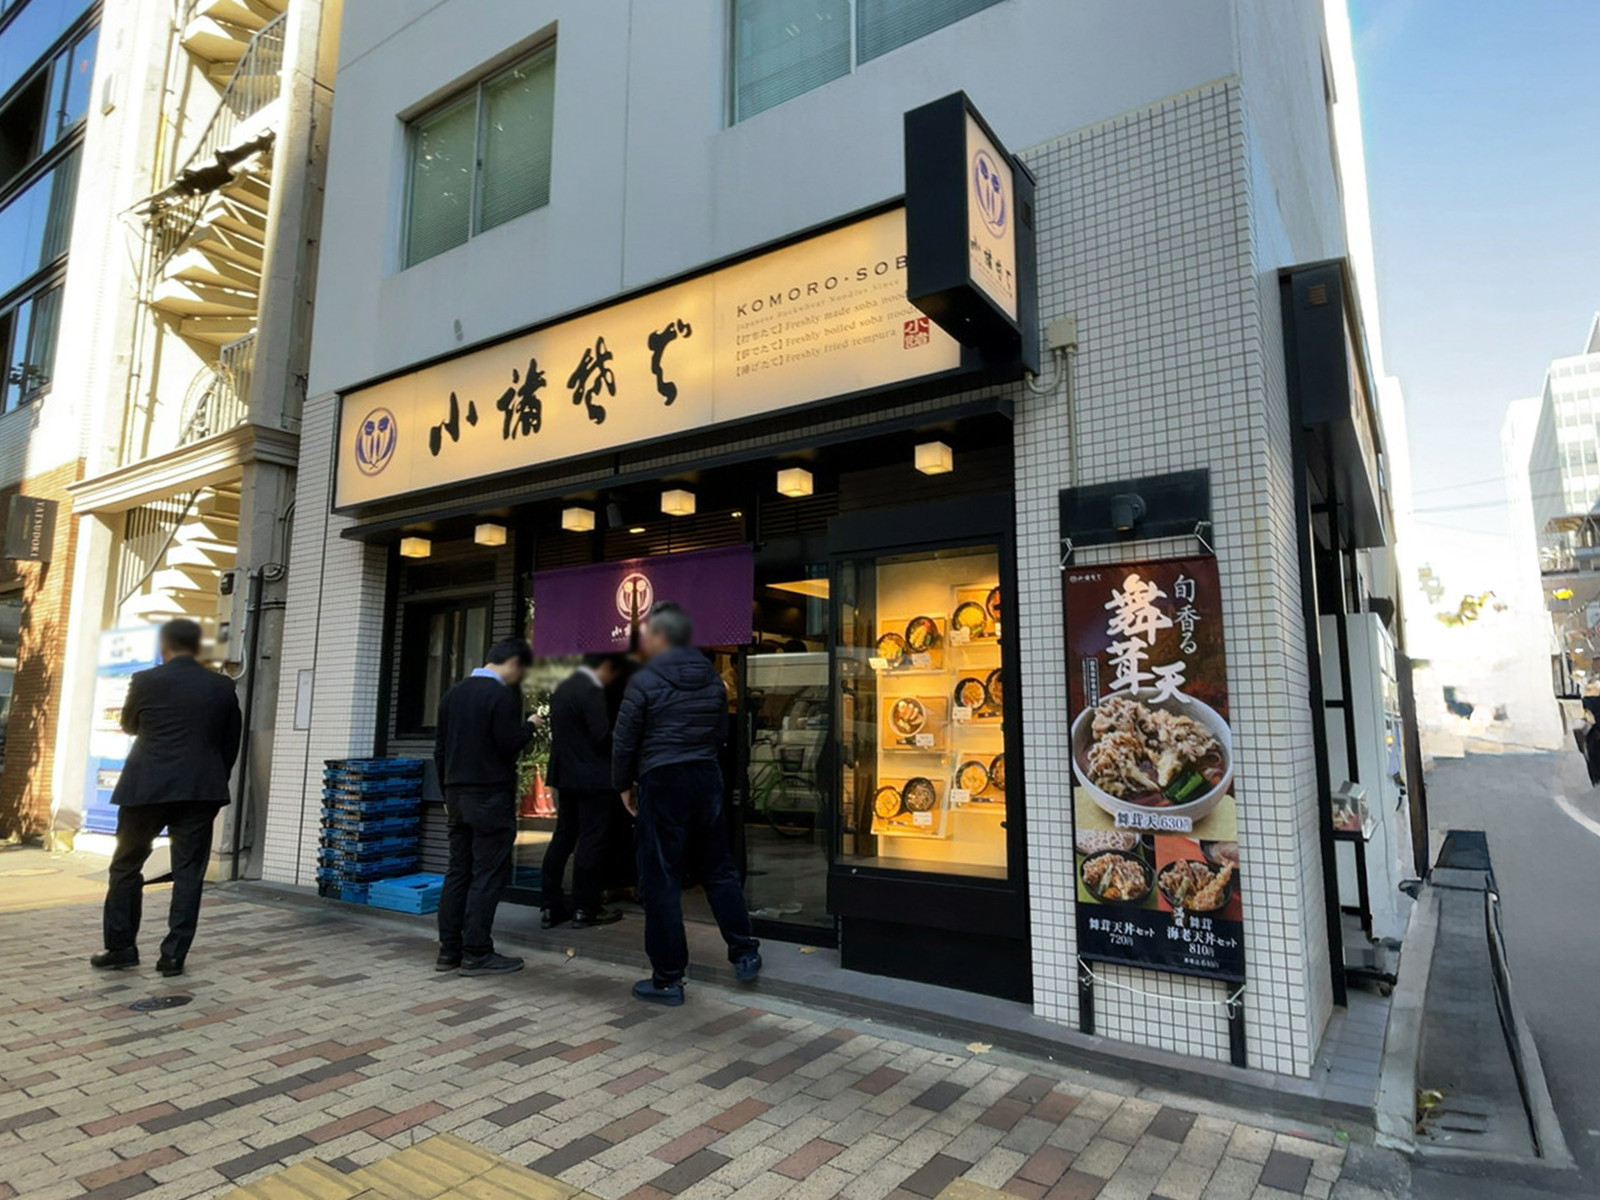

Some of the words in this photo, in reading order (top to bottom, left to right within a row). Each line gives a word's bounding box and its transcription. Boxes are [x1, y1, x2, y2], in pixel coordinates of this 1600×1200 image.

[786, 314, 819, 331] Freshly
[824, 303, 851, 320] made
[786, 330, 819, 347] Freshly
[824, 320, 856, 337] boiled
[786, 346, 819, 363] Freshly
[824, 338, 849, 354] fried
[852, 328, 897, 347] tempura
[30, 500, 46, 558] YATSUDOKI
[1174, 574, 1201, 655] 旬香る
[1104, 573, 1191, 704] 舞茸天
[1188, 943, 1215, 958] 810円
